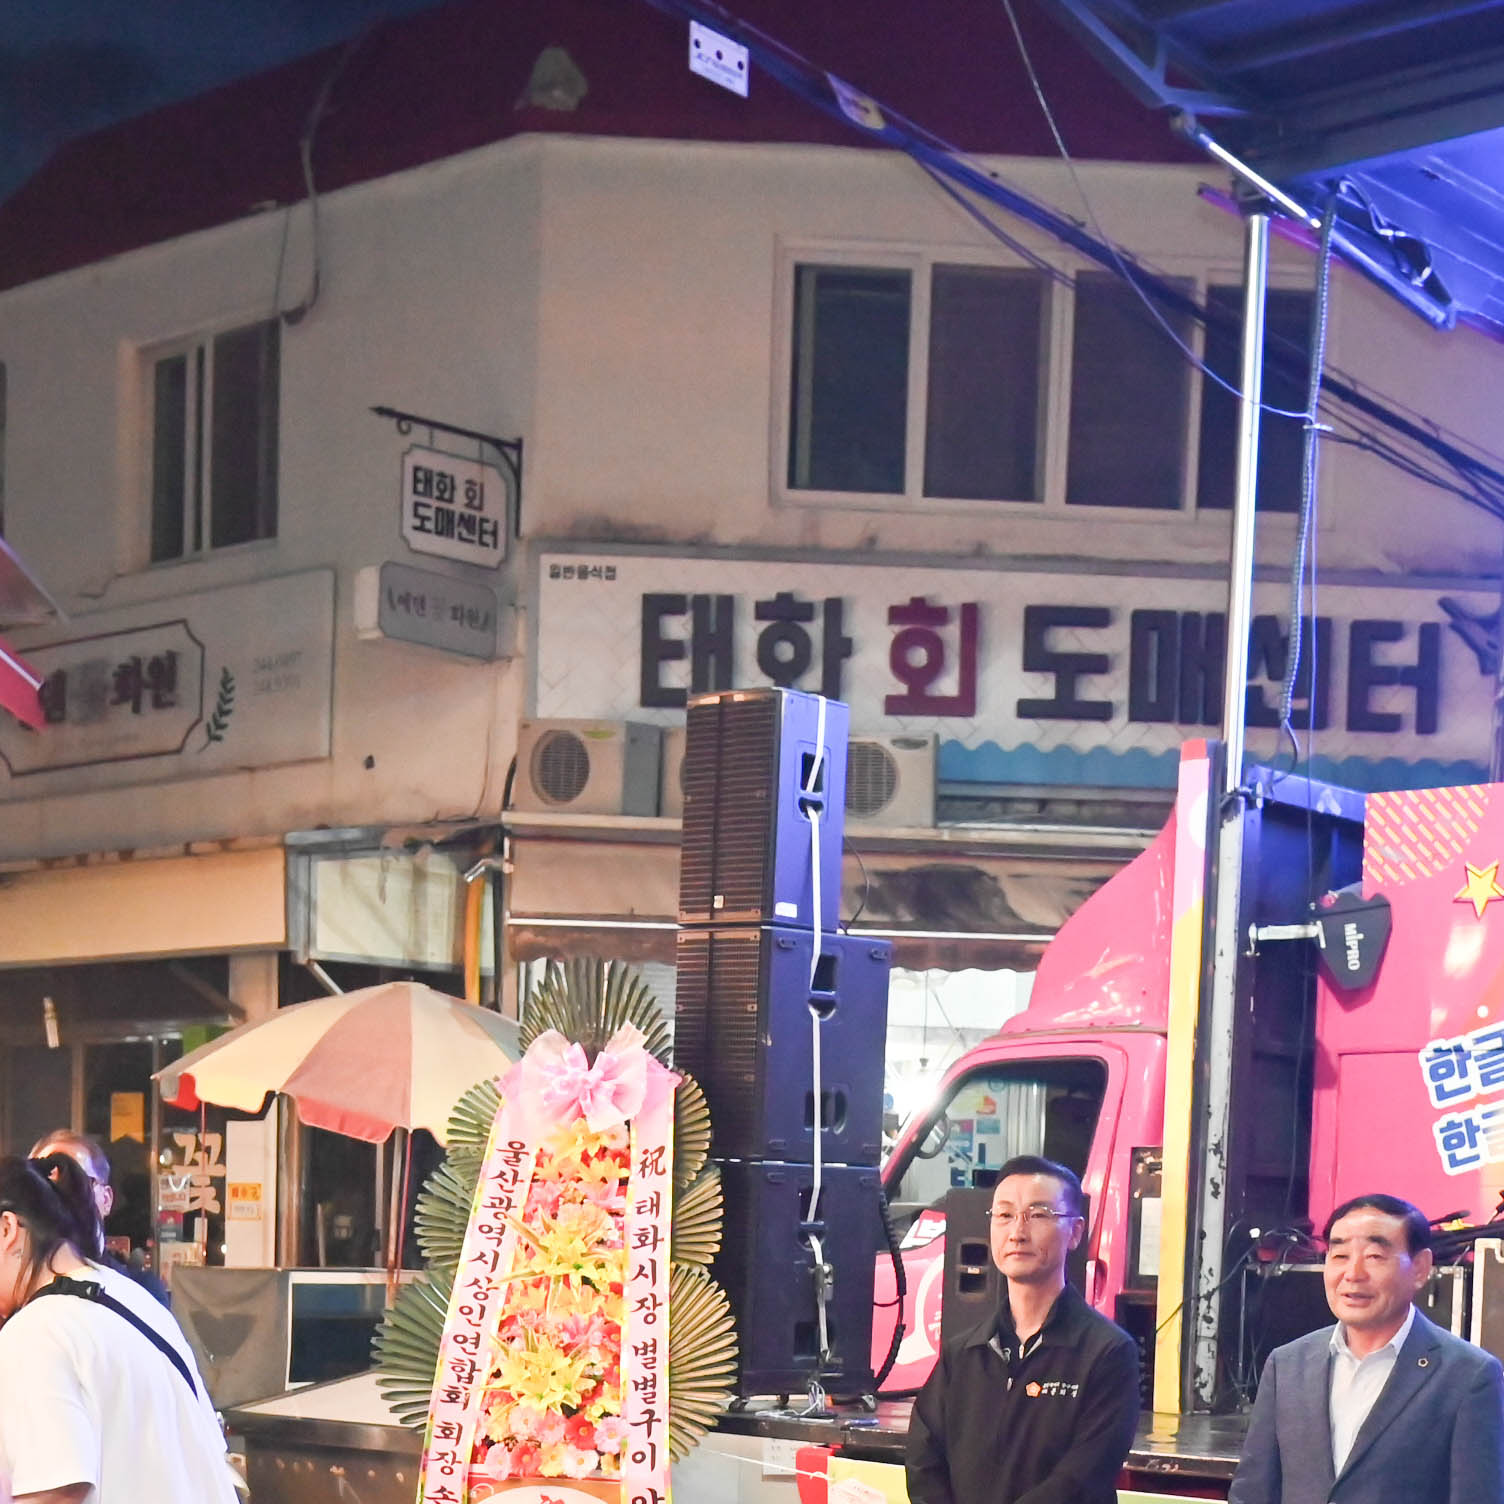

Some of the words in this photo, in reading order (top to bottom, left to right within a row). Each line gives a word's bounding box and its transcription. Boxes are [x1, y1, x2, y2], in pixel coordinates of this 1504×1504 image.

[412, 465, 456, 504] 태화
[464, 478, 484, 511] 회
[412, 501, 498, 550] 도매센터
[549, 563, 616, 581] 일반음식점
[884, 596, 979, 717] 회
[1016, 604, 1442, 735] 도매센터
[171, 1132, 227, 1214] 꽃
[637, 1146, 666, 1176] 祝
[439, 1140, 530, 1411] 울산광역시상인연합회
[630, 1193, 665, 1326] 태화시장
[628, 1335, 663, 1472] 별별구이
[428, 1420, 463, 1475] 회장
